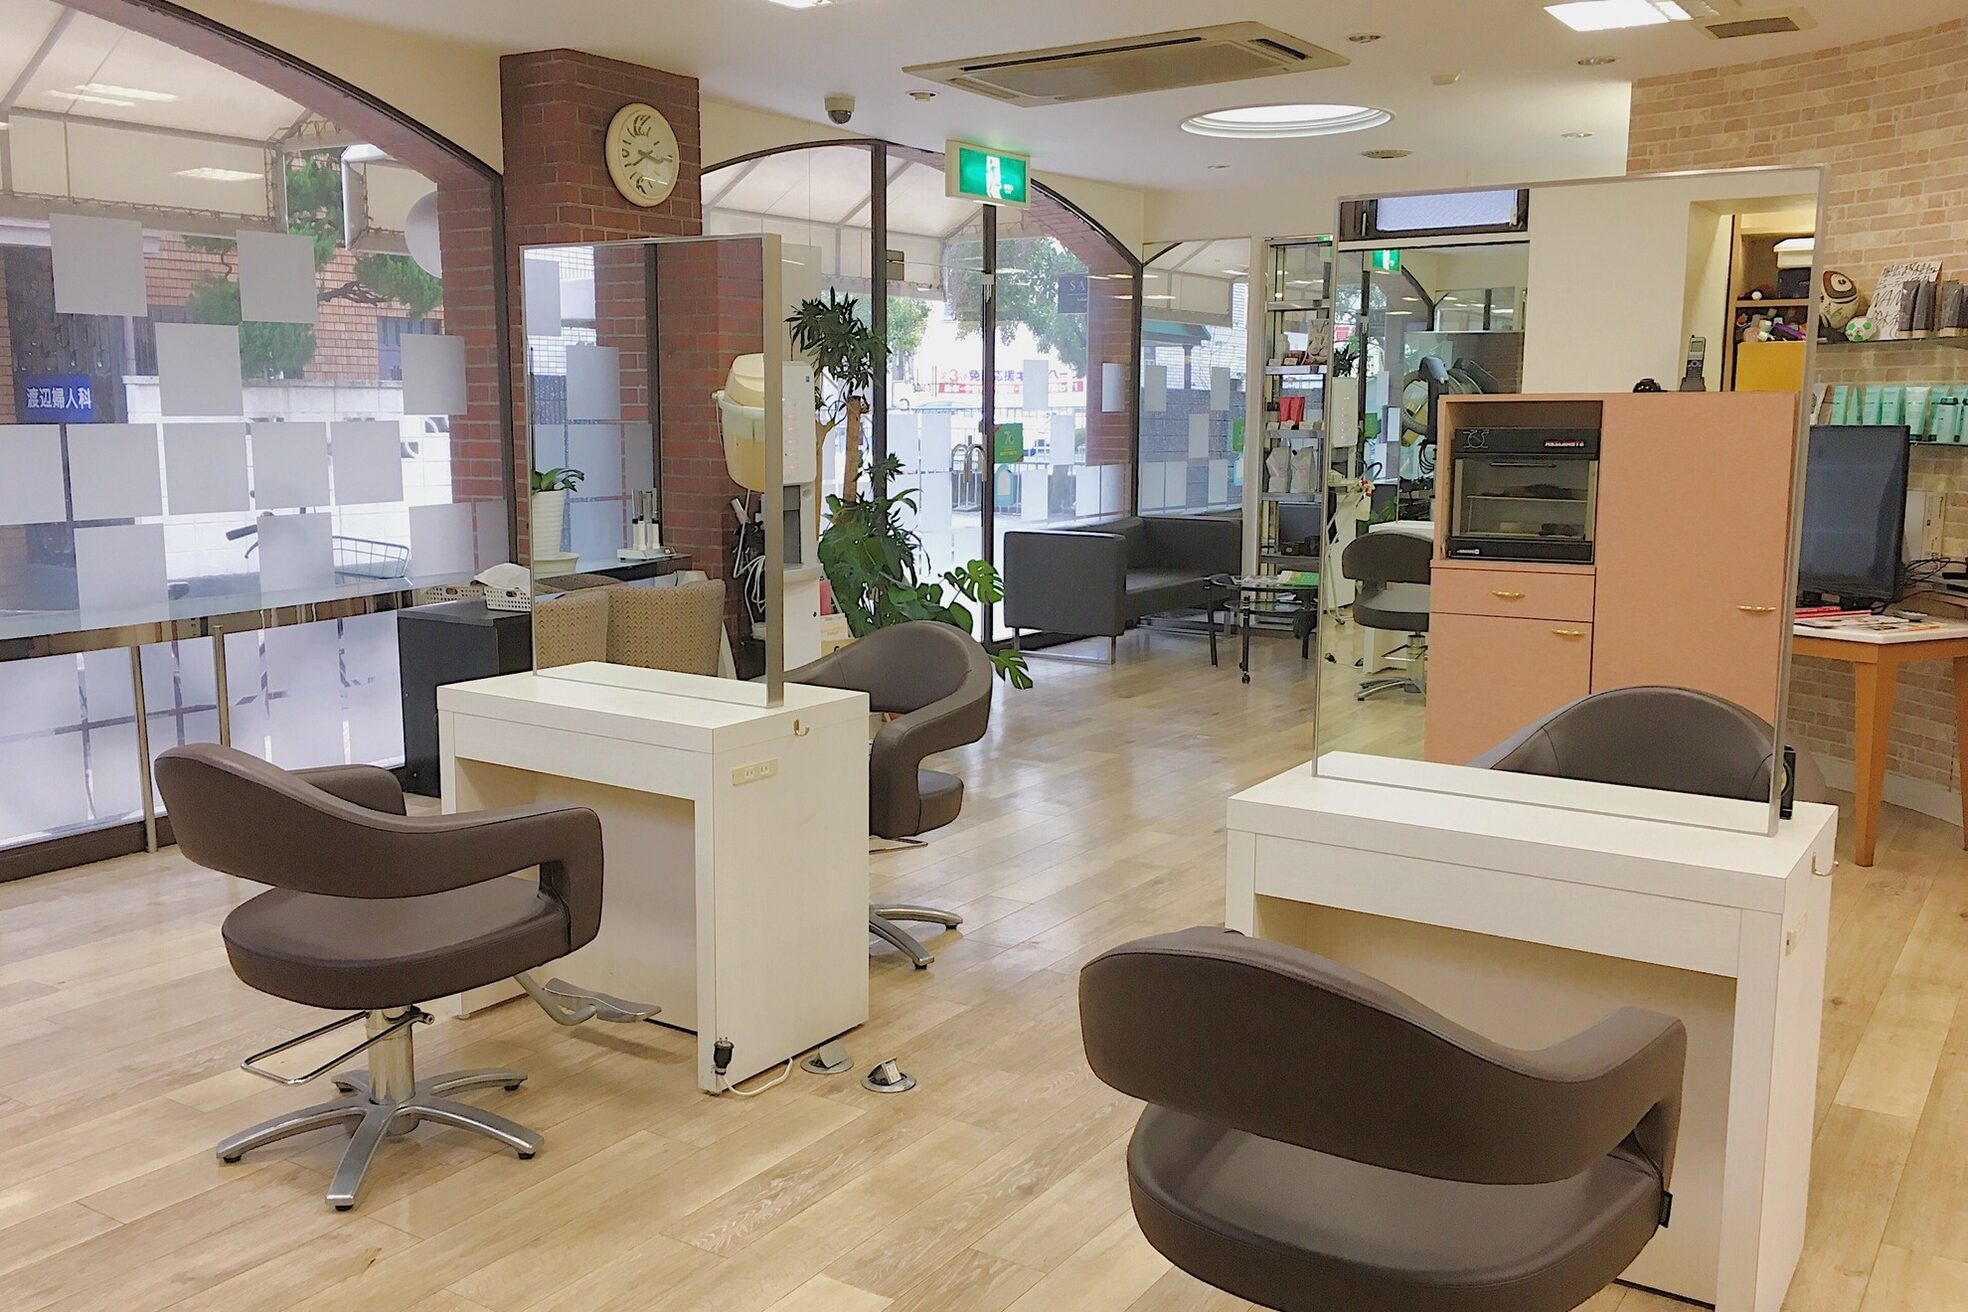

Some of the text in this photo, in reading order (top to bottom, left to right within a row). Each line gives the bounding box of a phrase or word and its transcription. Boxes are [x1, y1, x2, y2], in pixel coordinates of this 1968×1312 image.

[26, 386, 92, 410] 渡辺婦人科
